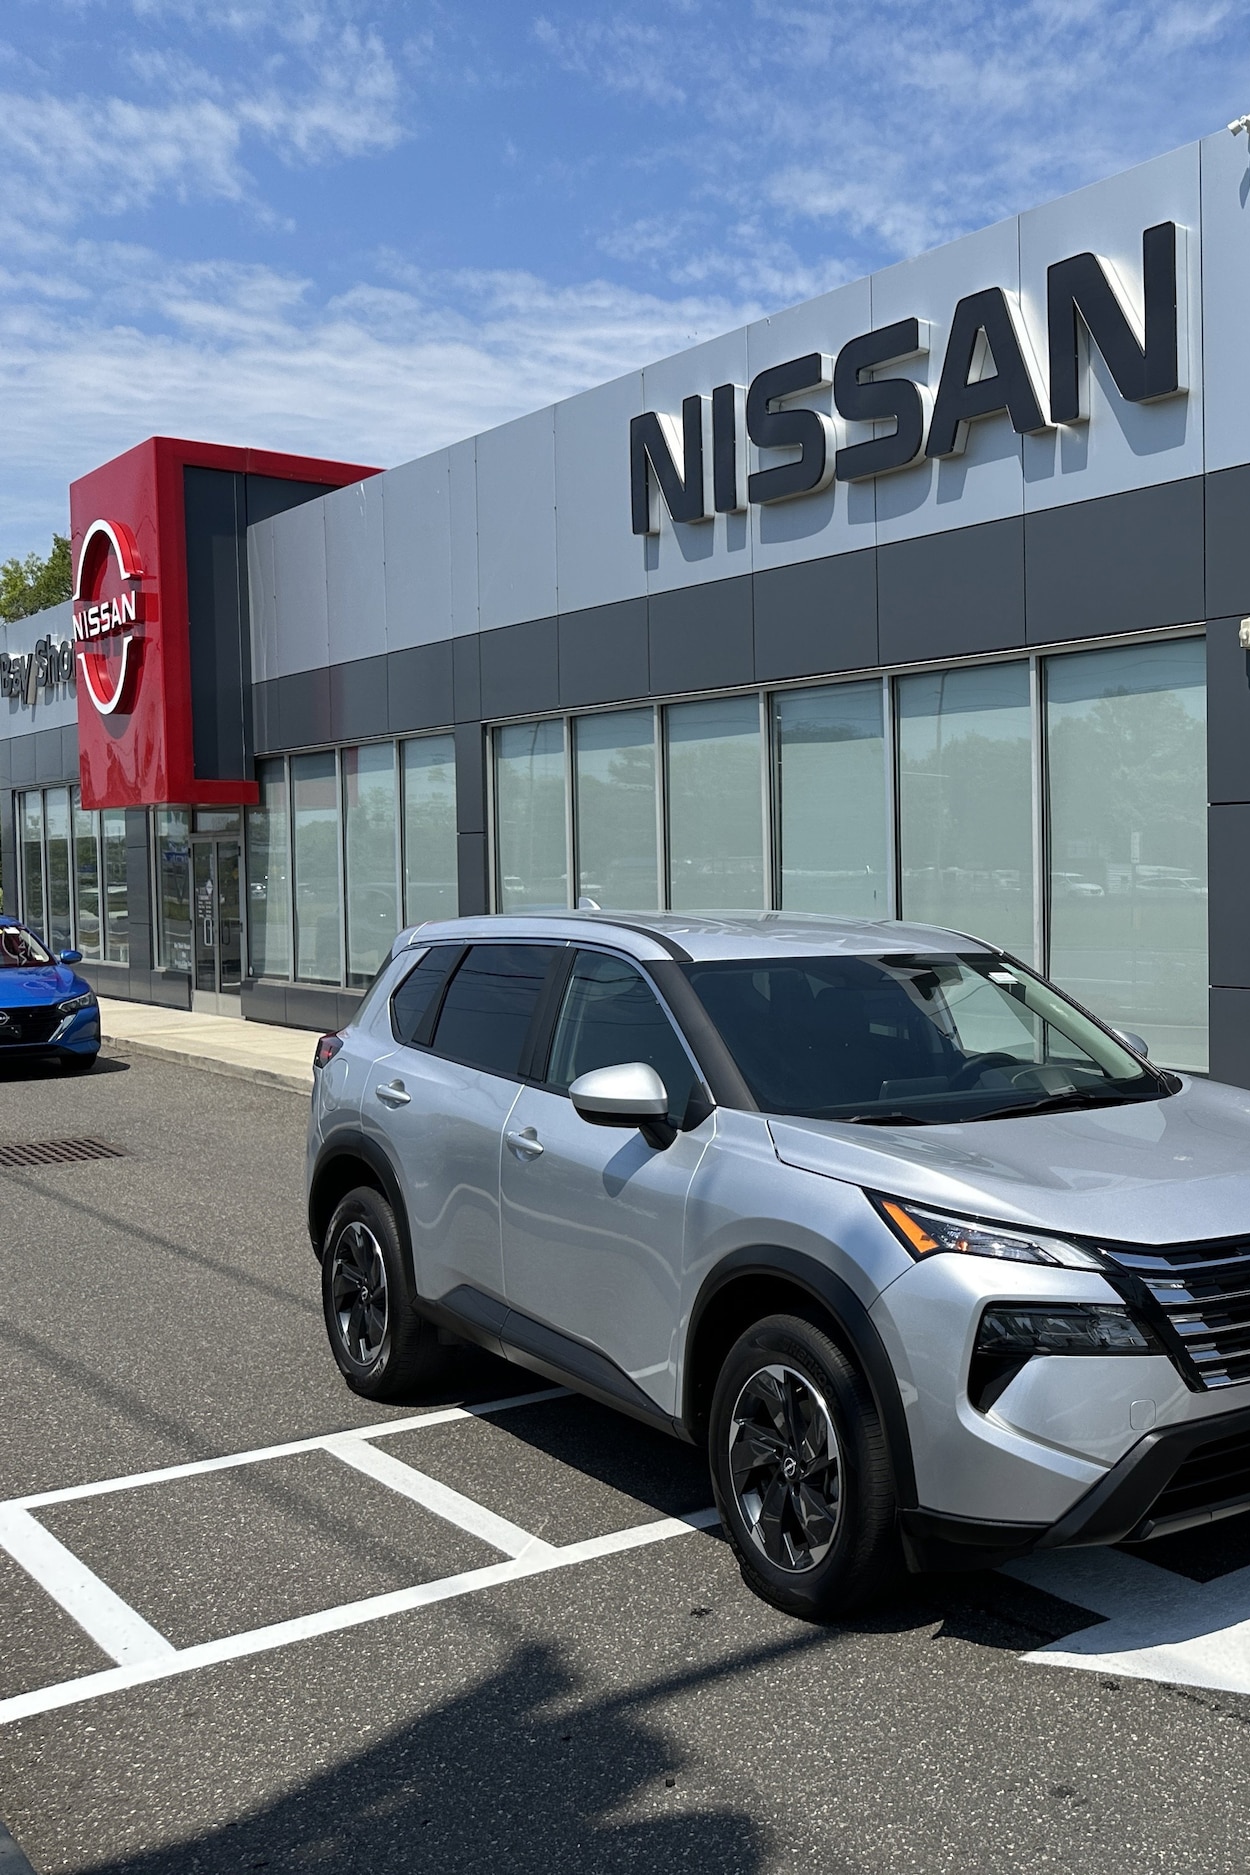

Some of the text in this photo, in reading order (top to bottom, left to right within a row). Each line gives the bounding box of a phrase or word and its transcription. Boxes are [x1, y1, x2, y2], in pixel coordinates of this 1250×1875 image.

[630, 221, 1188, 535] NISSAN
[72, 590, 136, 642] NISSAN
[0, 652, 34, 705] Bay
